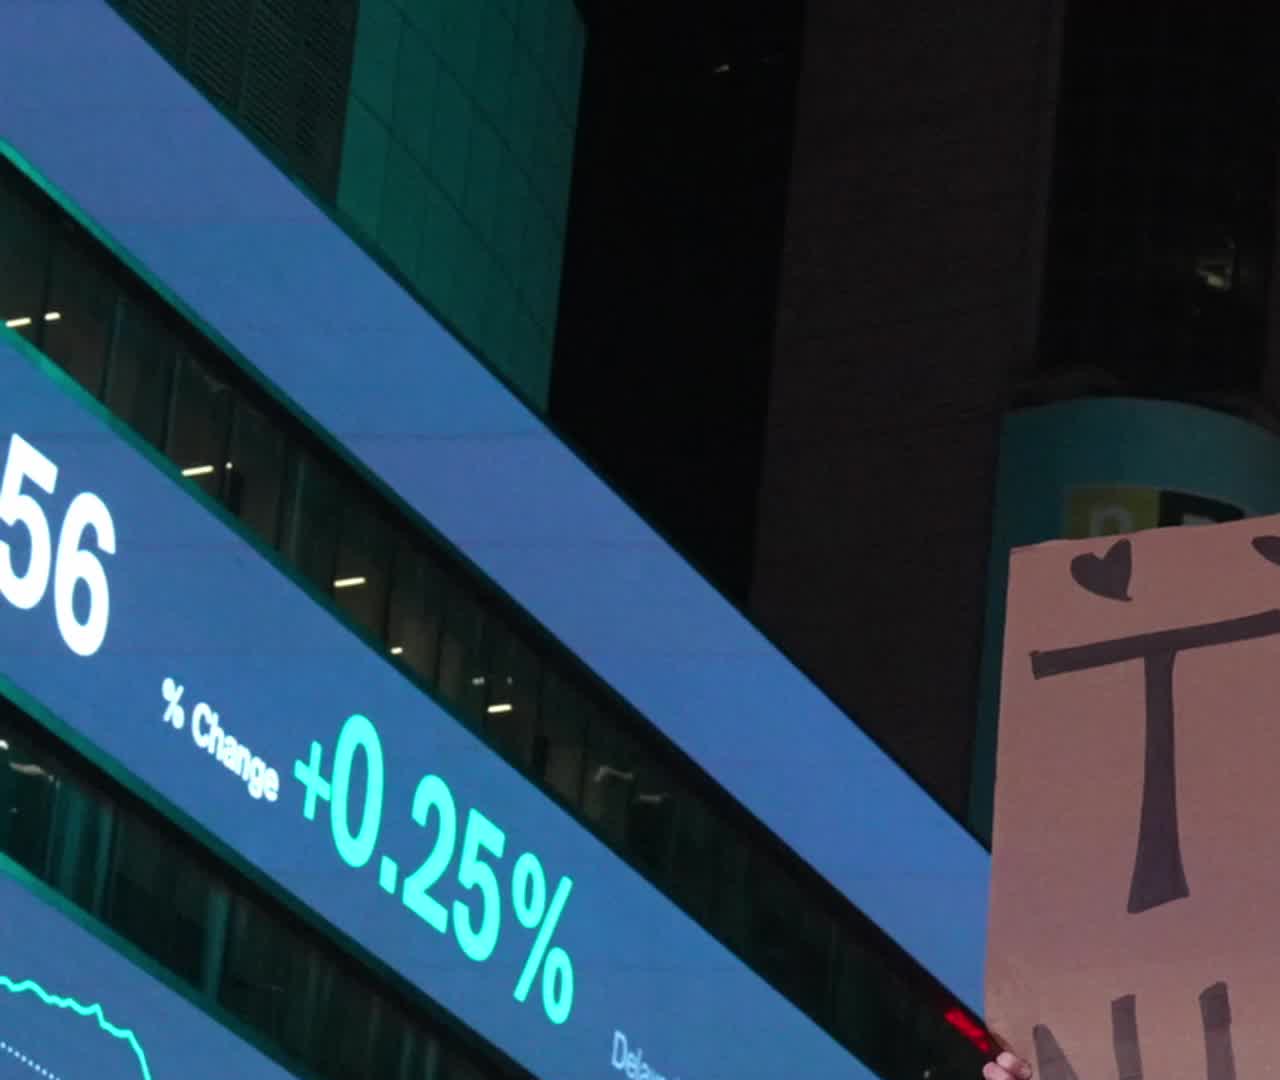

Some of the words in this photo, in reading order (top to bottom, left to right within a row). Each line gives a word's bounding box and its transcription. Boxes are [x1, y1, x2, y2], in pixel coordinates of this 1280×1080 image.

[0, 433, 116, 656] 56
[191, 702, 279, 802] Change
[294, 714, 574, 1024] +0.25%
